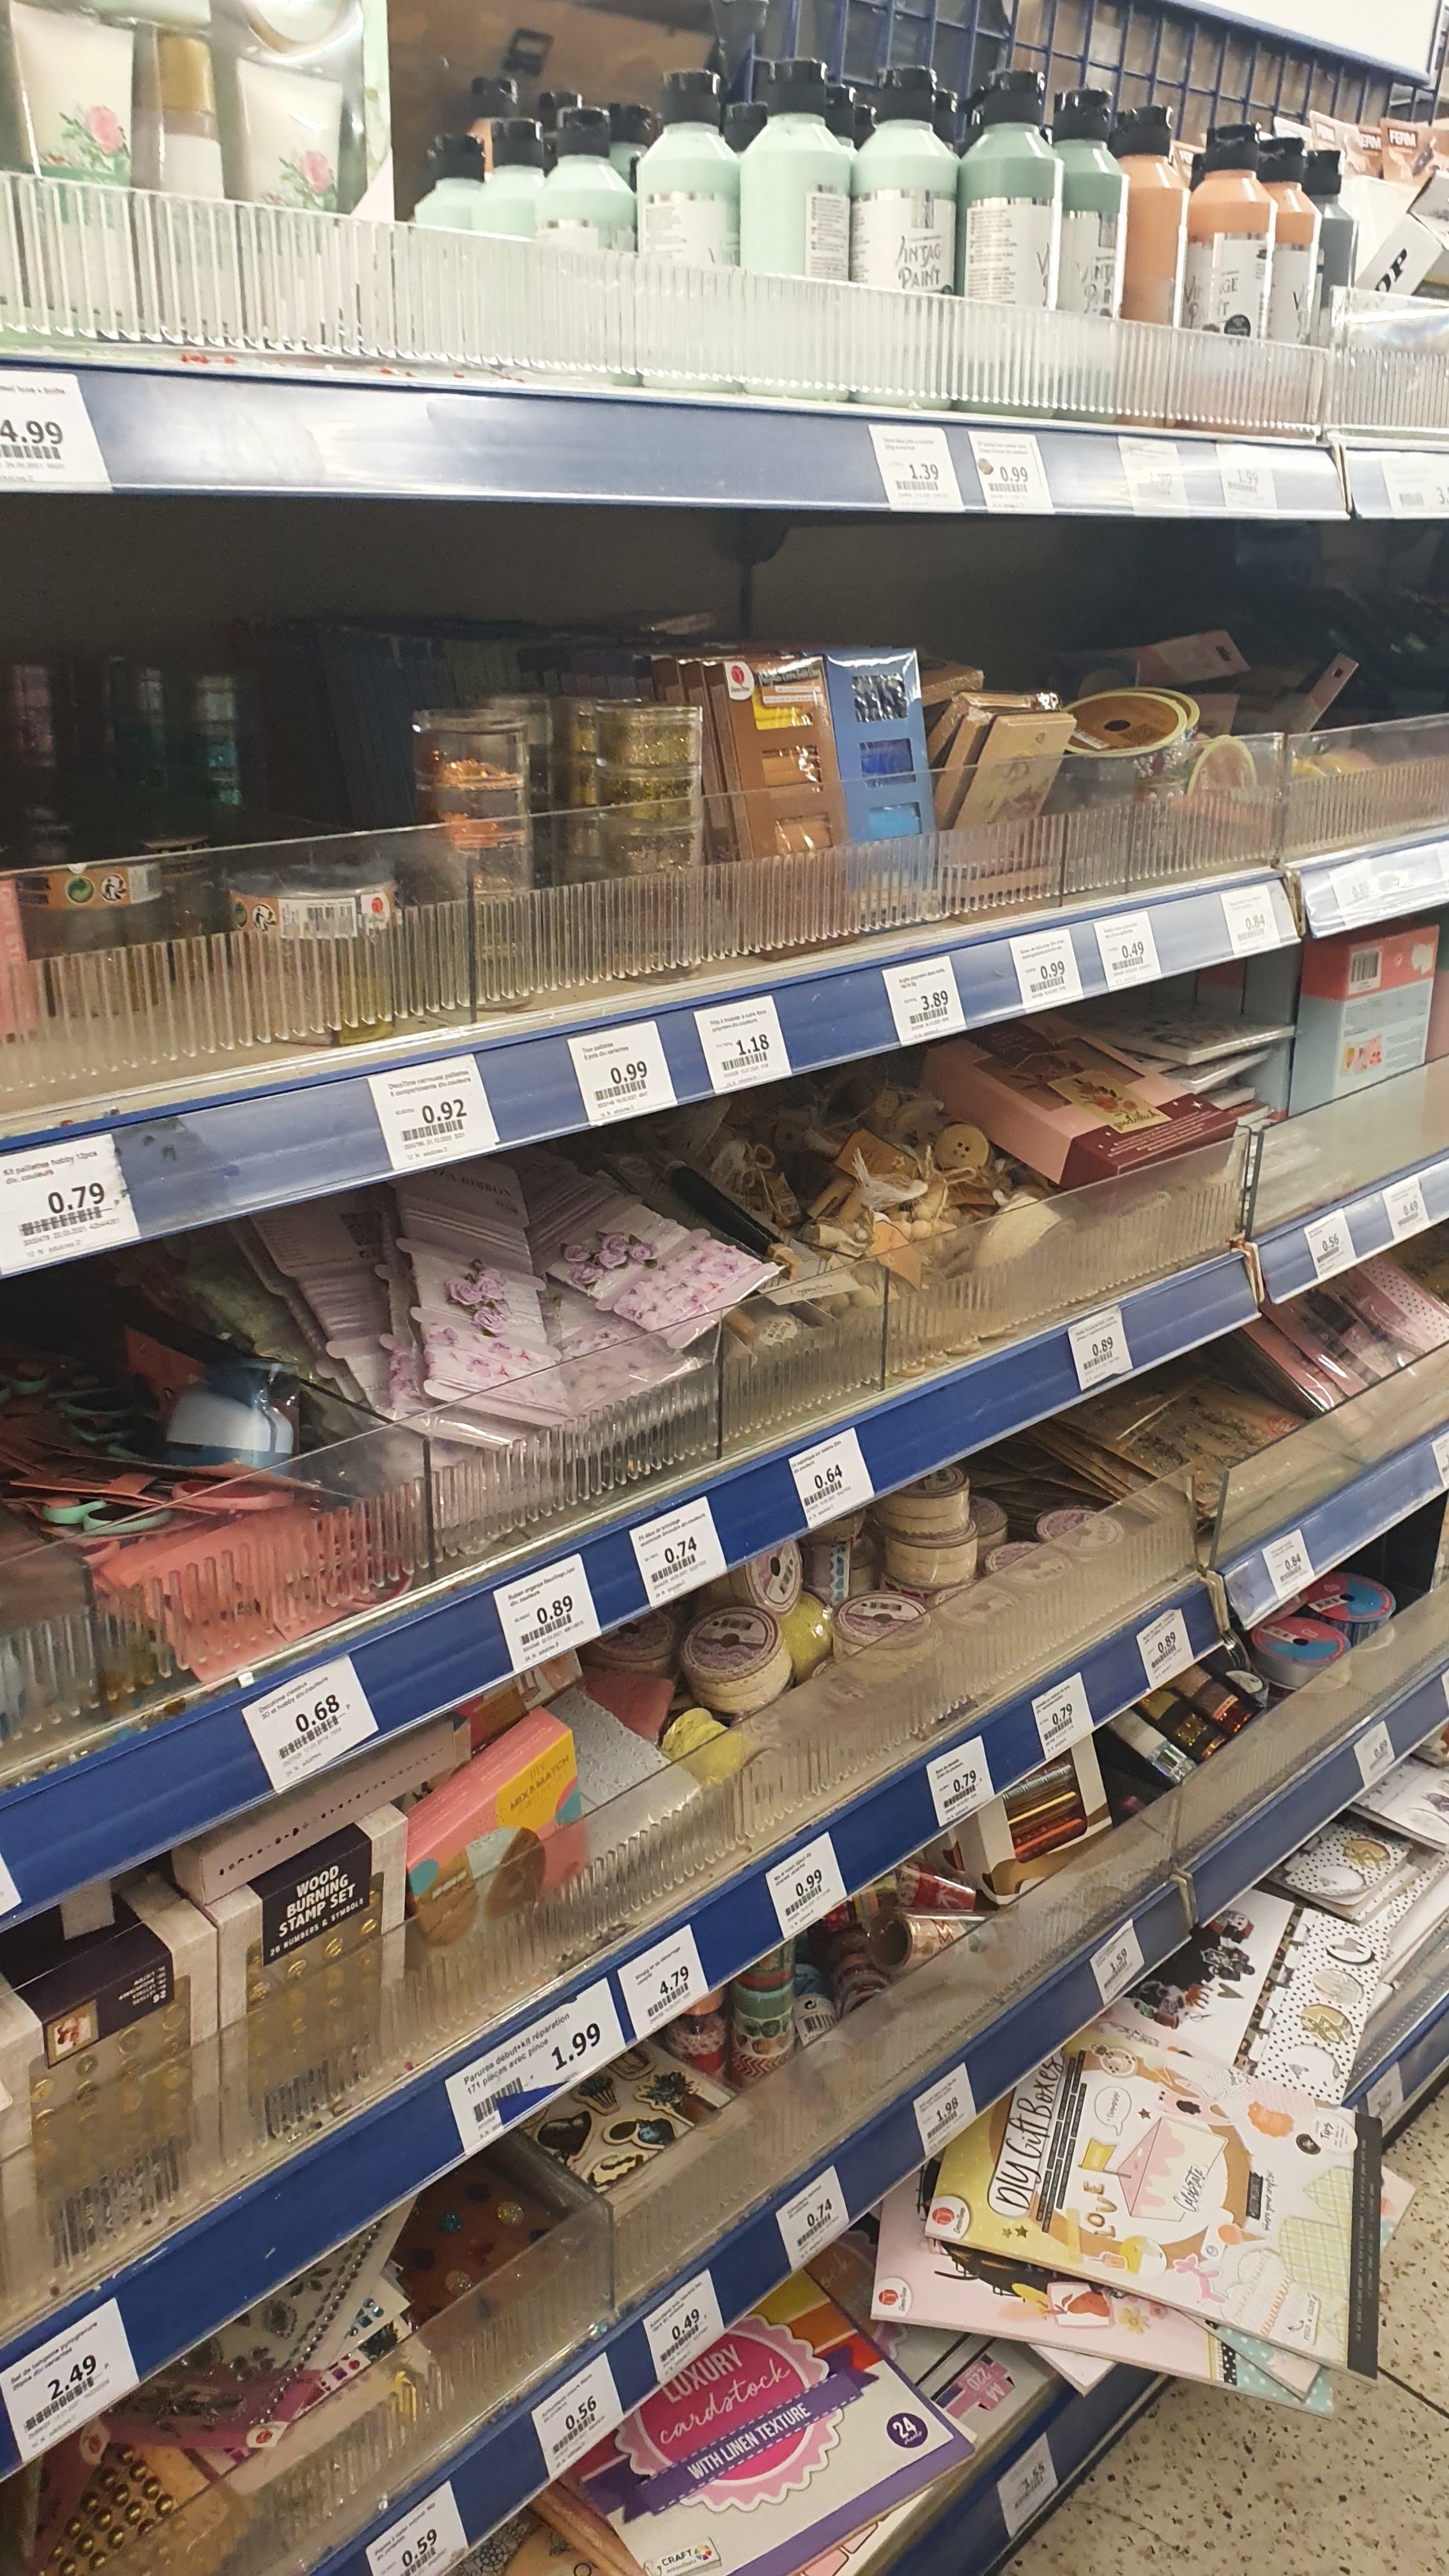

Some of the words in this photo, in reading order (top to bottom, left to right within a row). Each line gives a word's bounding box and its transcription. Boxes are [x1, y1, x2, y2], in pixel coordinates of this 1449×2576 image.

[1390, 131, 1416, 148] FERM
[909, 463, 939, 480] 1.39
[999, 466, 1028, 482] 0.99
[1237, 470, 1259, 486] 1.99
[1245, 914, 1266, 930] 0.84
[1121, 941, 1144, 960] 0.49
[1040, 960, 1066, 980] 0.99
[921, 990, 948, 1011] 3.89
[736, 1034, 769, 1055] 1.18
[611, 1061, 647, 1085] 0.99
[422, 1098, 467, 1124] 0.92
[50, 1155, 75, 1166] hobby
[48, 1183, 105, 1214] 0.79
[1403, 1200, 1418, 1216] 0.49
[1322, 1233, 1340, 1252] 0.56
[1092, 1336, 1113, 1356] 0.89
[814, 1464, 842, 1489] 0.64
[664, 1536, 696, 1564] 0.74
[1285, 1553, 1301, 1570] 0.84
[537, 1595, 573, 1625] 0.89
[1158, 1631, 1176, 1653] 0.89
[277, 1699, 296, 1710] hobby
[295, 1694, 340, 1732] 0.68
[1052, 1703, 1073, 1725] 0.79
[953, 1770, 976, 1792] 0.79
[296, 1865, 339, 1898] WOOD
[795, 1869, 822, 1897] 0.99
[286, 1874, 349, 1919] BURNING
[279, 1901, 326, 1938] STAMP
[330, 1883, 356, 1909] SET
[283, 1924, 319, 1949] NUMBERS
[321, 1919, 328, 1927] &
[331, 1897, 364, 1922] SYMBOLS
[1110, 1947, 1128, 1971] 1.59
[660, 1965, 689, 1995] 4.79
[464, 2060, 494, 2085] Parures
[532, 2012, 570, 2041] réparation
[551, 2023, 601, 2071] 1.99
[467, 2082, 481, 2096] 171
[482, 2064, 508, 2087] pièces
[509, 2053, 527, 2069] avec
[528, 2038, 549, 2058] pince
[1017, 2055, 1064, 2120] Boxes
[936, 2096, 959, 2122] 1.98
[1006, 2113, 1051, 2159] Gift
[995, 2159, 1041, 2211] DIY
[1173, 2165, 1207, 2212] Celebrate
[807, 2198, 832, 2227] 0.74
[1082, 2181, 1117, 2238] LOVE
[671, 2308, 700, 2340] 0.49
[47, 2354, 96, 2400] 2.49
[661, 2344, 744, 2404] LUXURY
[965, 2367, 991, 2390] 220
[660, 2358, 791, 2445] cardstock
[985, 2382, 1006, 2404] A4
[565, 2395, 597, 2430] 0.56
[893, 2416, 917, 2439] 24
[687, 2453, 724, 2480] WITH
[721, 2432, 760, 2461] LINEN
[755, 2402, 812, 2442] TEXTURE
[402, 2529, 437, 2567] 0.59
[661, 2549, 692, 2566] CRAFT
